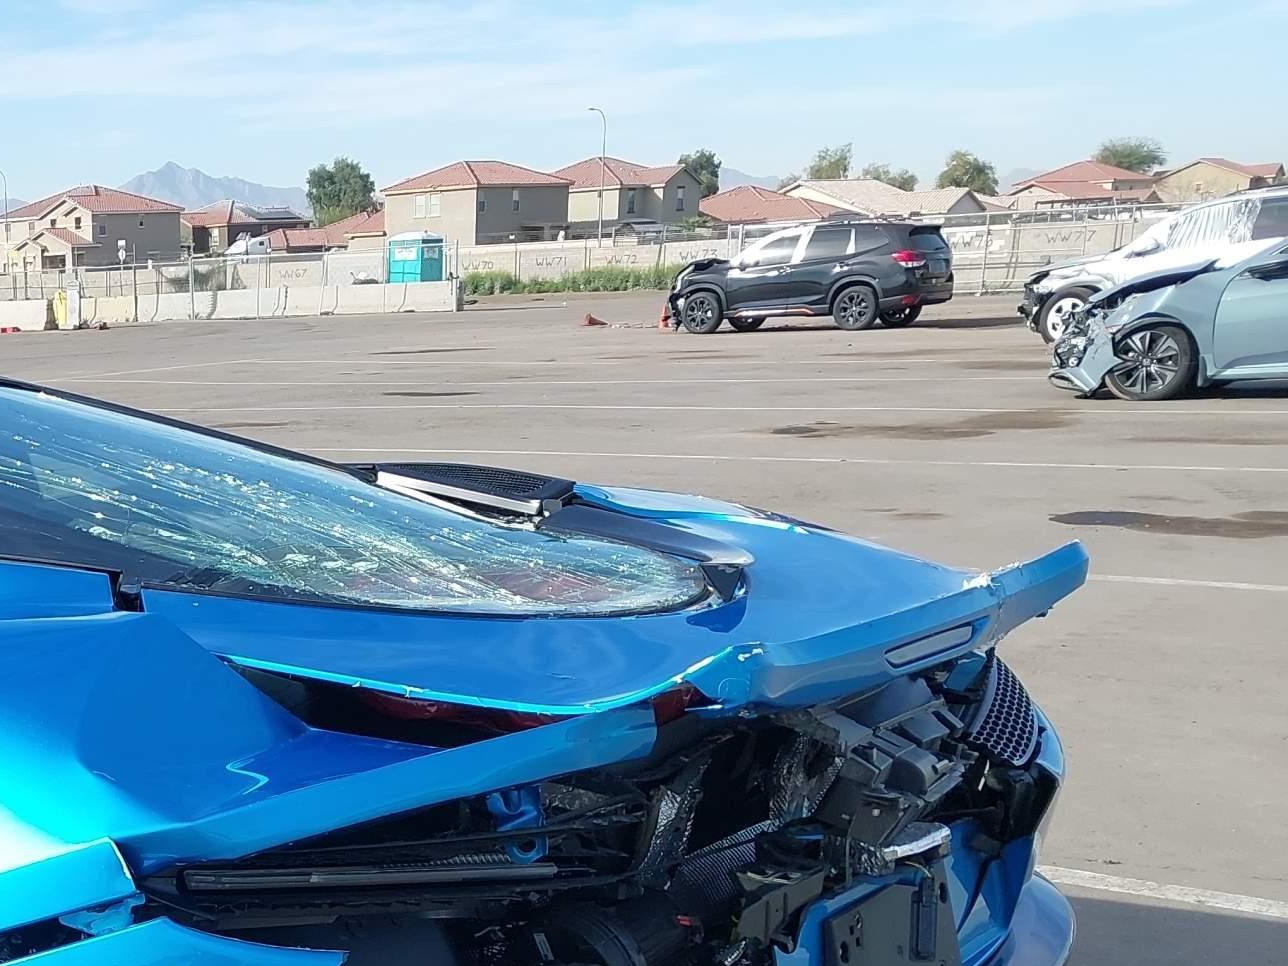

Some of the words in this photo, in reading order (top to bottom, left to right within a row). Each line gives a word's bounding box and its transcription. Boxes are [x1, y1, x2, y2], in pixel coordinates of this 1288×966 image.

[1046, 231, 1096, 244] WW77
[535, 256, 567, 267] WW71
[604, 254, 638, 265] WW72
[462, 261, 494, 271] WW70
[278, 268, 308, 280] WW67
